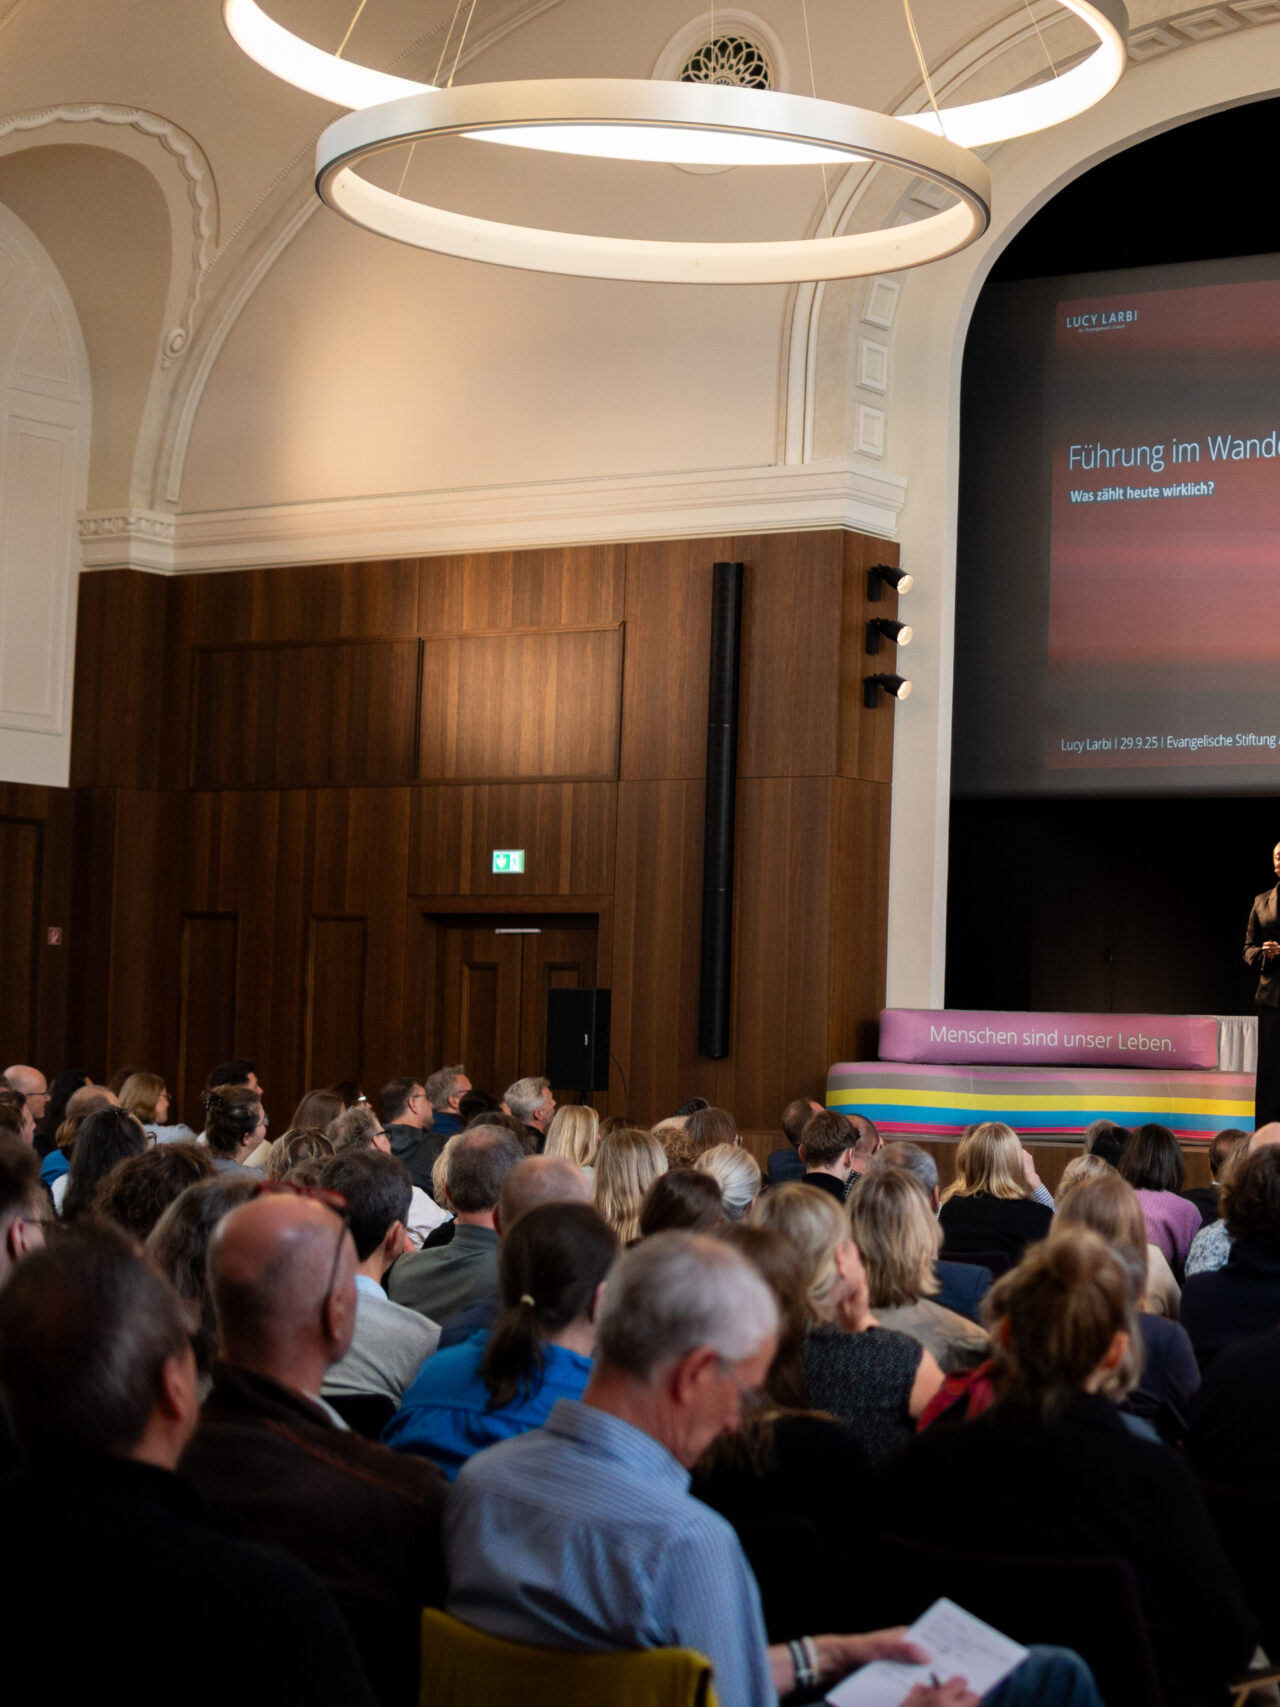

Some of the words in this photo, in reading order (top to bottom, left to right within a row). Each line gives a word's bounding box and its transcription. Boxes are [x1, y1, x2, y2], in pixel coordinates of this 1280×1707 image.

[1066, 313, 1098, 329] LUCY
[1101, 310, 1138, 325] LARBI
[1068, 442, 1165, 473] Führung
[1172, 438, 1200, 464] im
[1070, 490, 1094, 503] Was
[1096, 486, 1124, 501] zählt
[1126, 486, 1160, 499] heute
[1162, 481, 1215, 497] wirklich?
[1061, 738, 1084, 754] Lucy
[1086, 738, 1112, 751] Larbi
[1120, 736, 1158, 750] 29.9.25
[1166, 735, 1233, 751] Evangelische
[1235, 733, 1277, 749] Stiftung
[930, 1025, 1018, 1046] Menschen
[1022, 1029, 1059, 1048] sind
[1063, 1032, 1112, 1049] unser
[1117, 1032, 1177, 1053] Leben.
